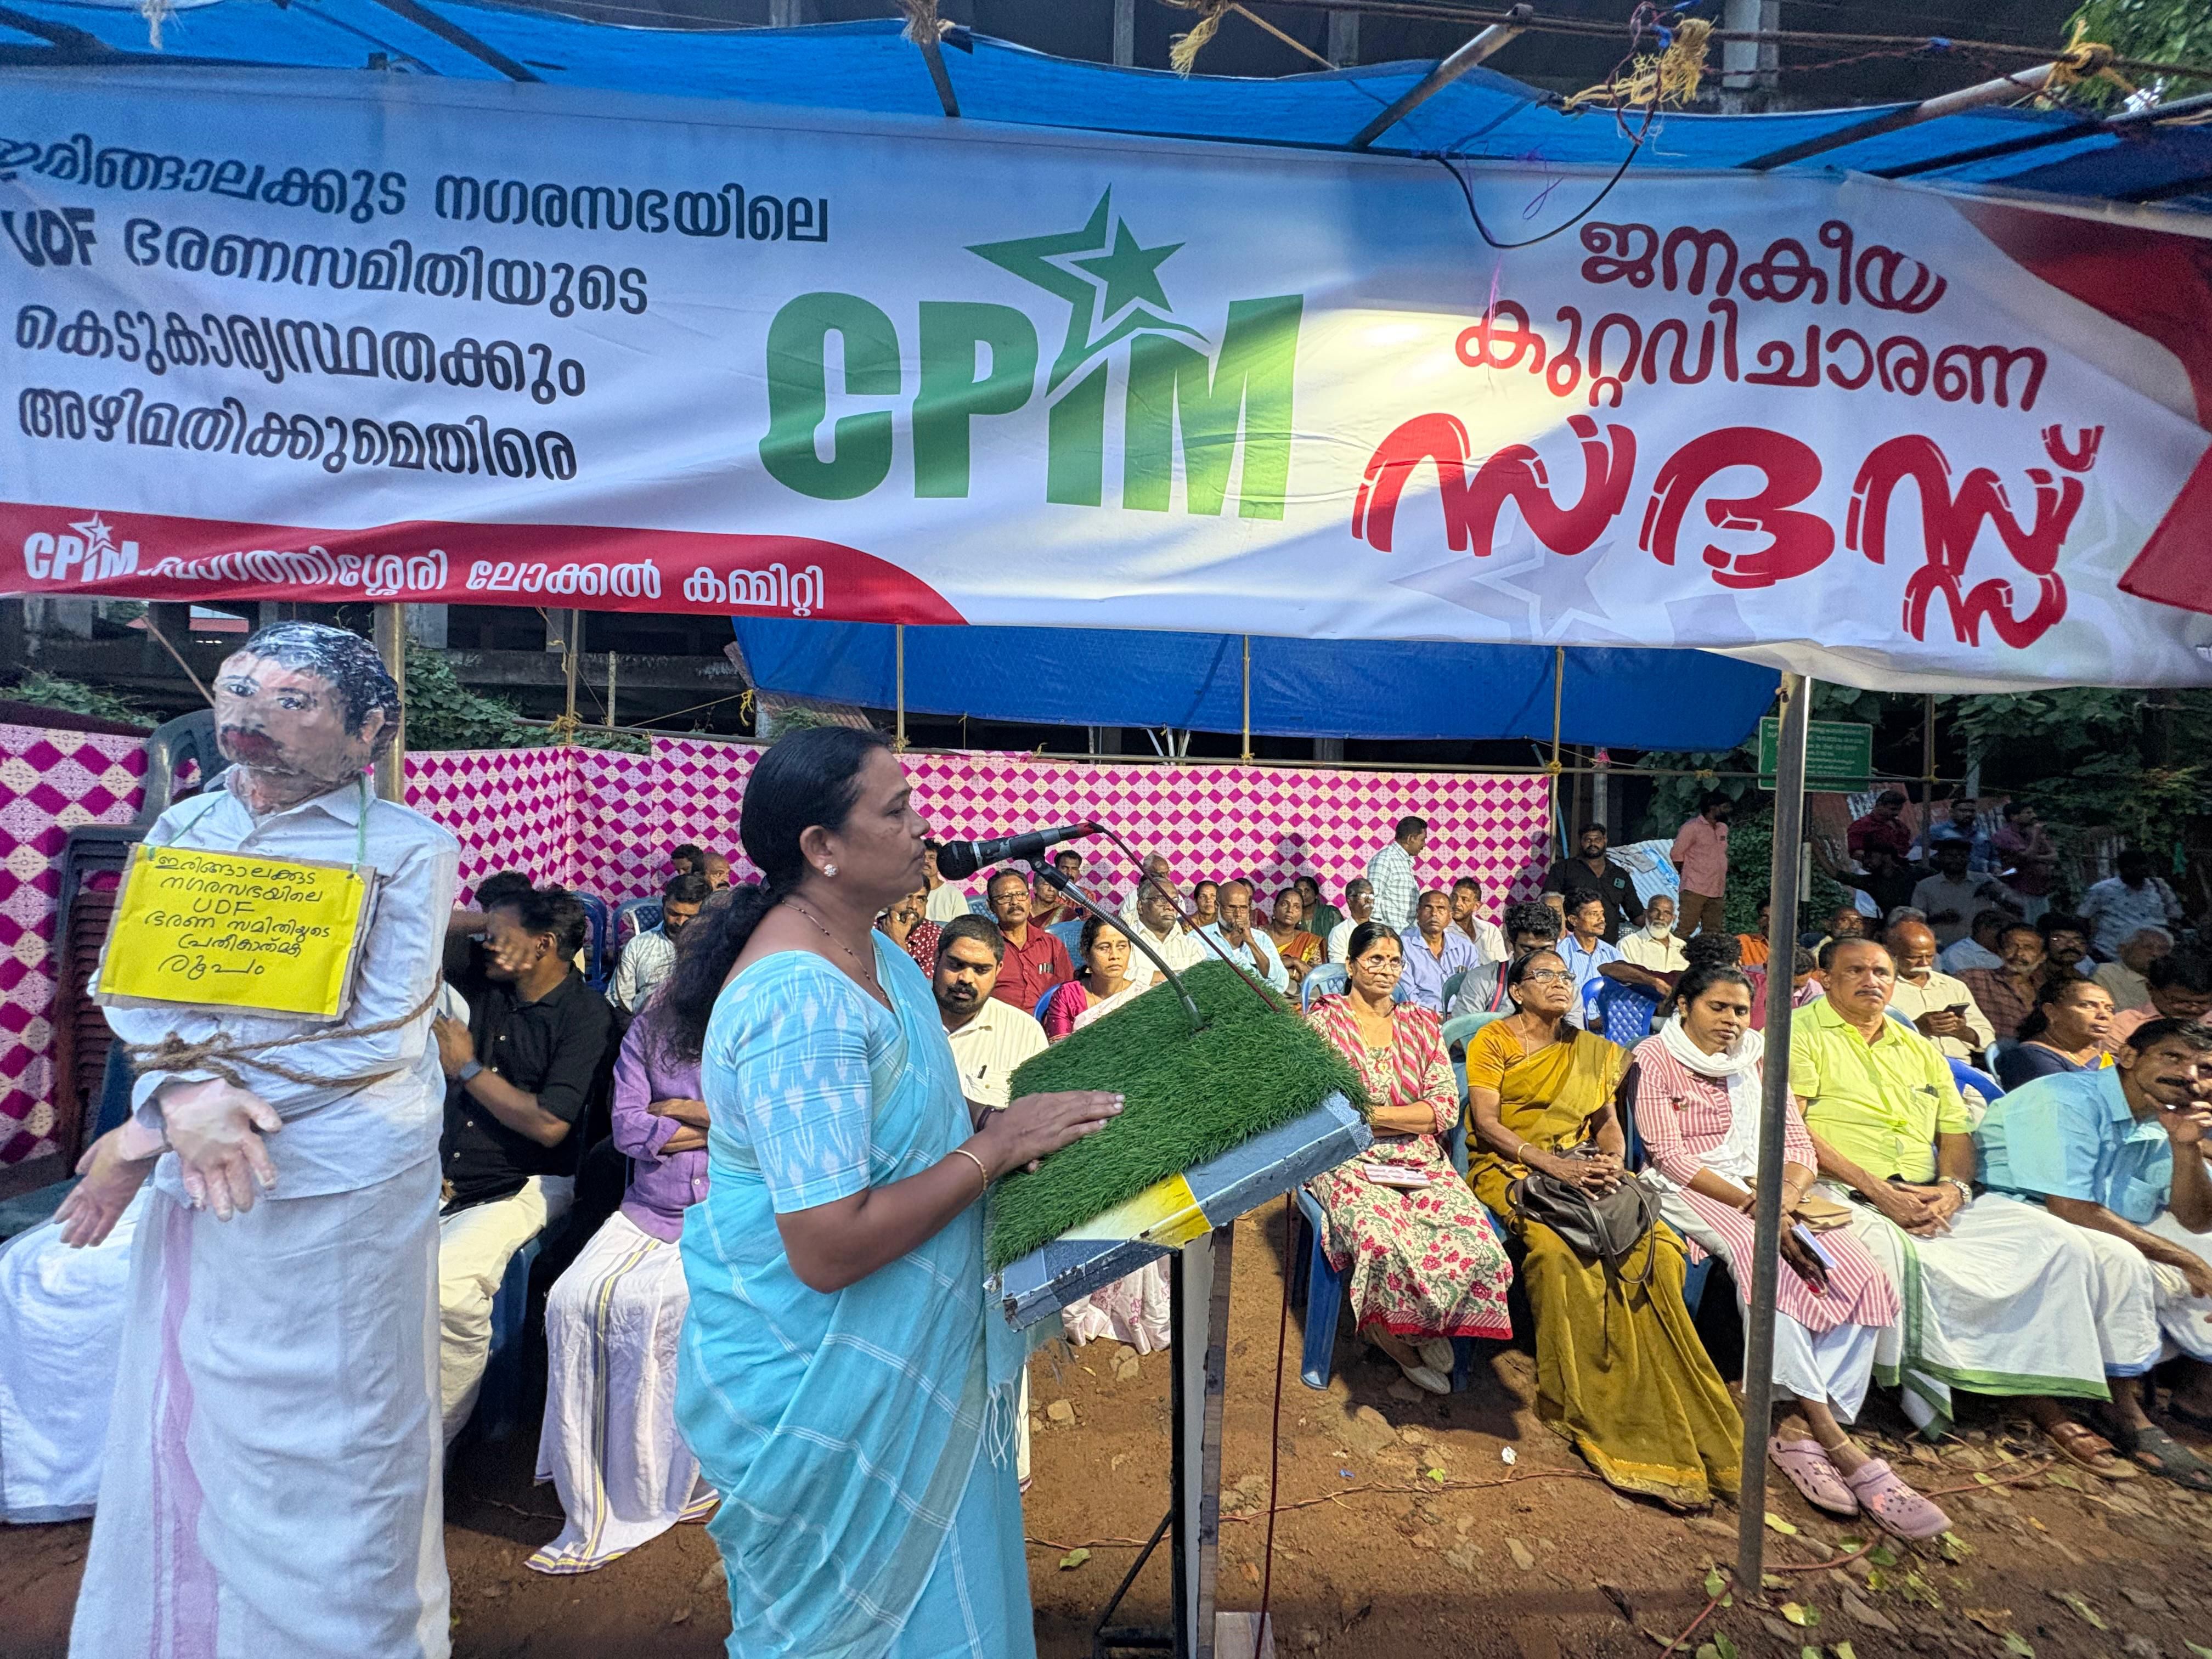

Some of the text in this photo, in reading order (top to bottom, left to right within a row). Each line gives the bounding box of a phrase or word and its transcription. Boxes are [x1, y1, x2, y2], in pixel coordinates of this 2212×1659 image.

[0, 134, 828, 242] ഇരിങ്ങാലക്കുട നഗരസഭയിലെ
[0, 208, 647, 318] UDF ഭരണസമിതിയുടെ
[1581, 219, 1946, 313] ജനകീയ
[16, 304, 585, 404] കെടുകാര്യസ്ഥതക്കും
[1455, 300, 2046, 410] കുറ്റവിചാരണ
[19, 388, 577, 479] അഴിമതിക്കുമെതിരെ
[760, 294, 1302, 519] CPIM
[24, 532, 145, 582] CPIM
[466, 559, 661, 599] ലോക്കൽ
[684, 563, 823, 616] കമ്മിറ്റി
[1352, 413, 2103, 649] സദസ്സ്
[155, 856, 315, 884] ഇരിങ്ങാലക്കുട
[160, 877, 323, 902] നഗരസഭയിലെ
[193, 898, 255, 915] UDF
[144, 910, 329, 941] ഭരണ സമിതിയുടെ
[158, 955, 264, 980] രൂപം
